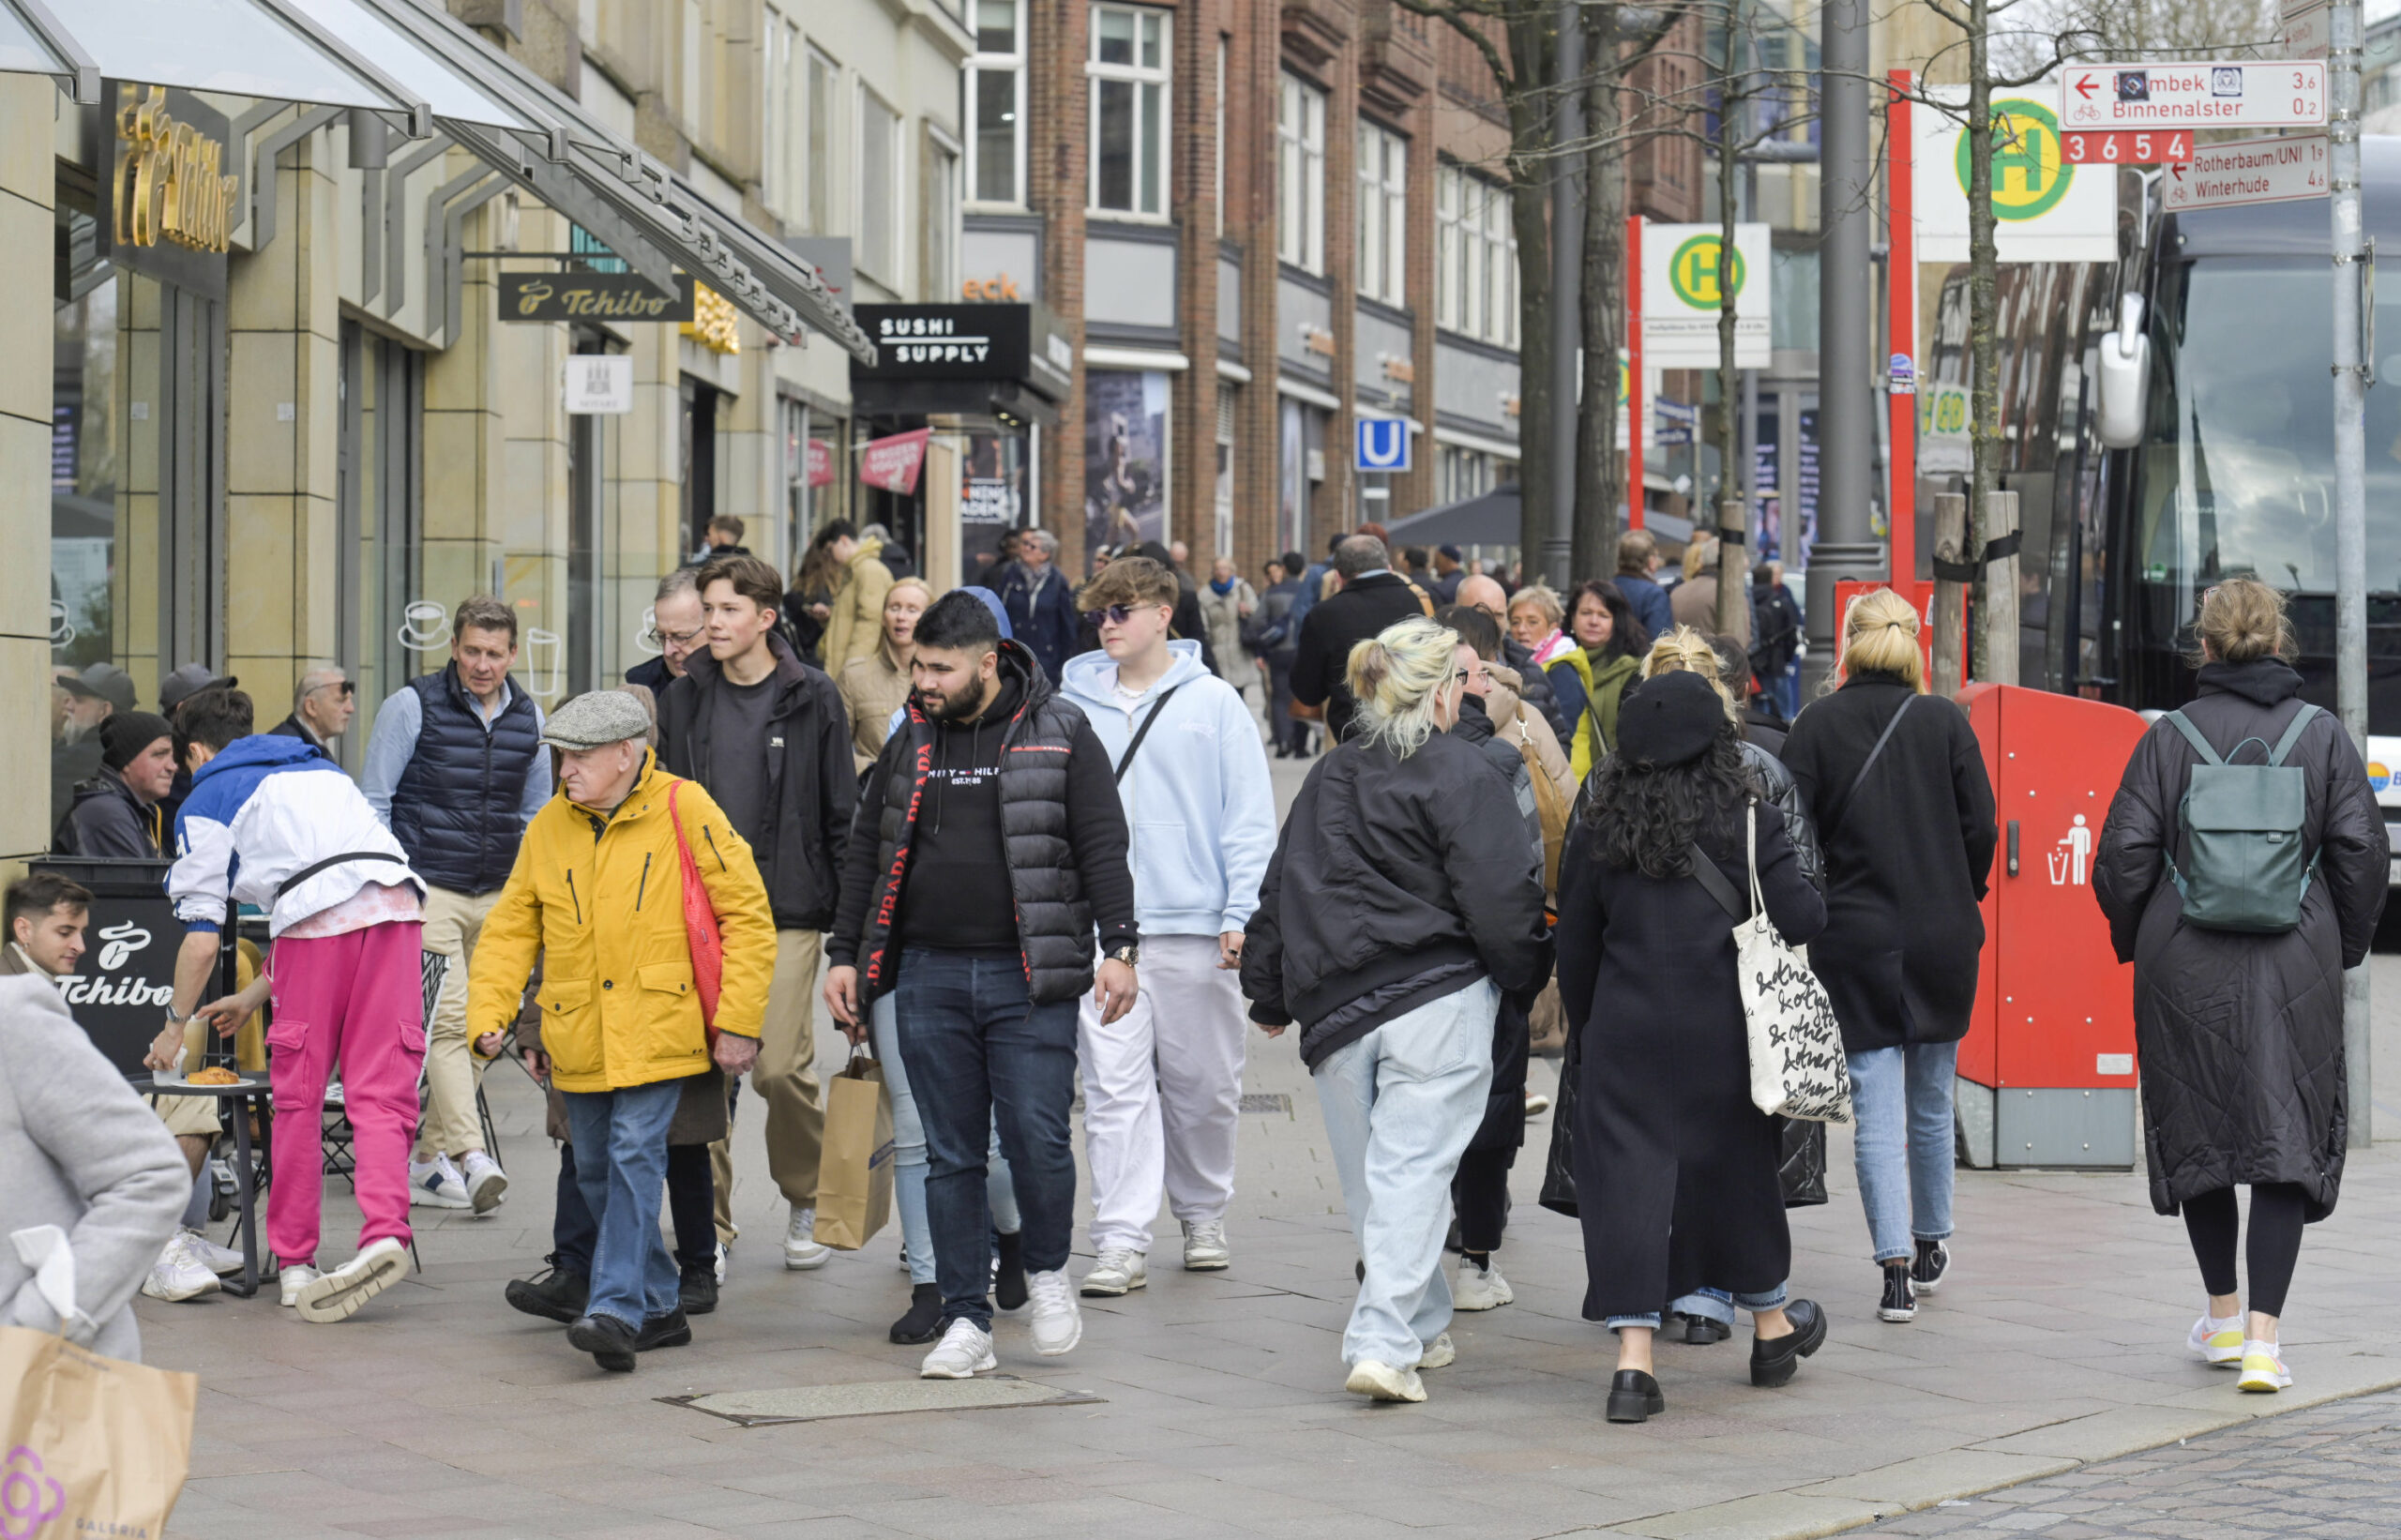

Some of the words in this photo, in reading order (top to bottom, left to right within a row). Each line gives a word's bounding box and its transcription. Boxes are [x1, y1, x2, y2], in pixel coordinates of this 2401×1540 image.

[2113, 74, 2205, 92] mbek
[2293, 72, 2316, 89] 3.6
[2113, 100, 2243, 118] Binnenalster
[2293, 98, 2317, 115] 0.2
[2069, 135, 2085, 160] 3
[2102, 135, 2118, 159] 6
[2136, 134, 2152, 159] 5
[2167, 134, 2185, 159] 4
[2195, 147, 2303, 174] Rotherbaum/UNI
[2196, 179, 2270, 198] Winterhude
[2308, 171, 2324, 187] 4.6
[1691, 252, 1722, 292] H
[562, 289, 672, 315] Tchibo
[880, 318, 954, 336] SUSHI
[897, 345, 989, 363] SUPPLY
[1363, 422, 1400, 466] U
[877, 848, 909, 926] PRADA
[54, 975, 174, 1006] Tchibo
[76, 1517, 147, 1539] GALERIA
